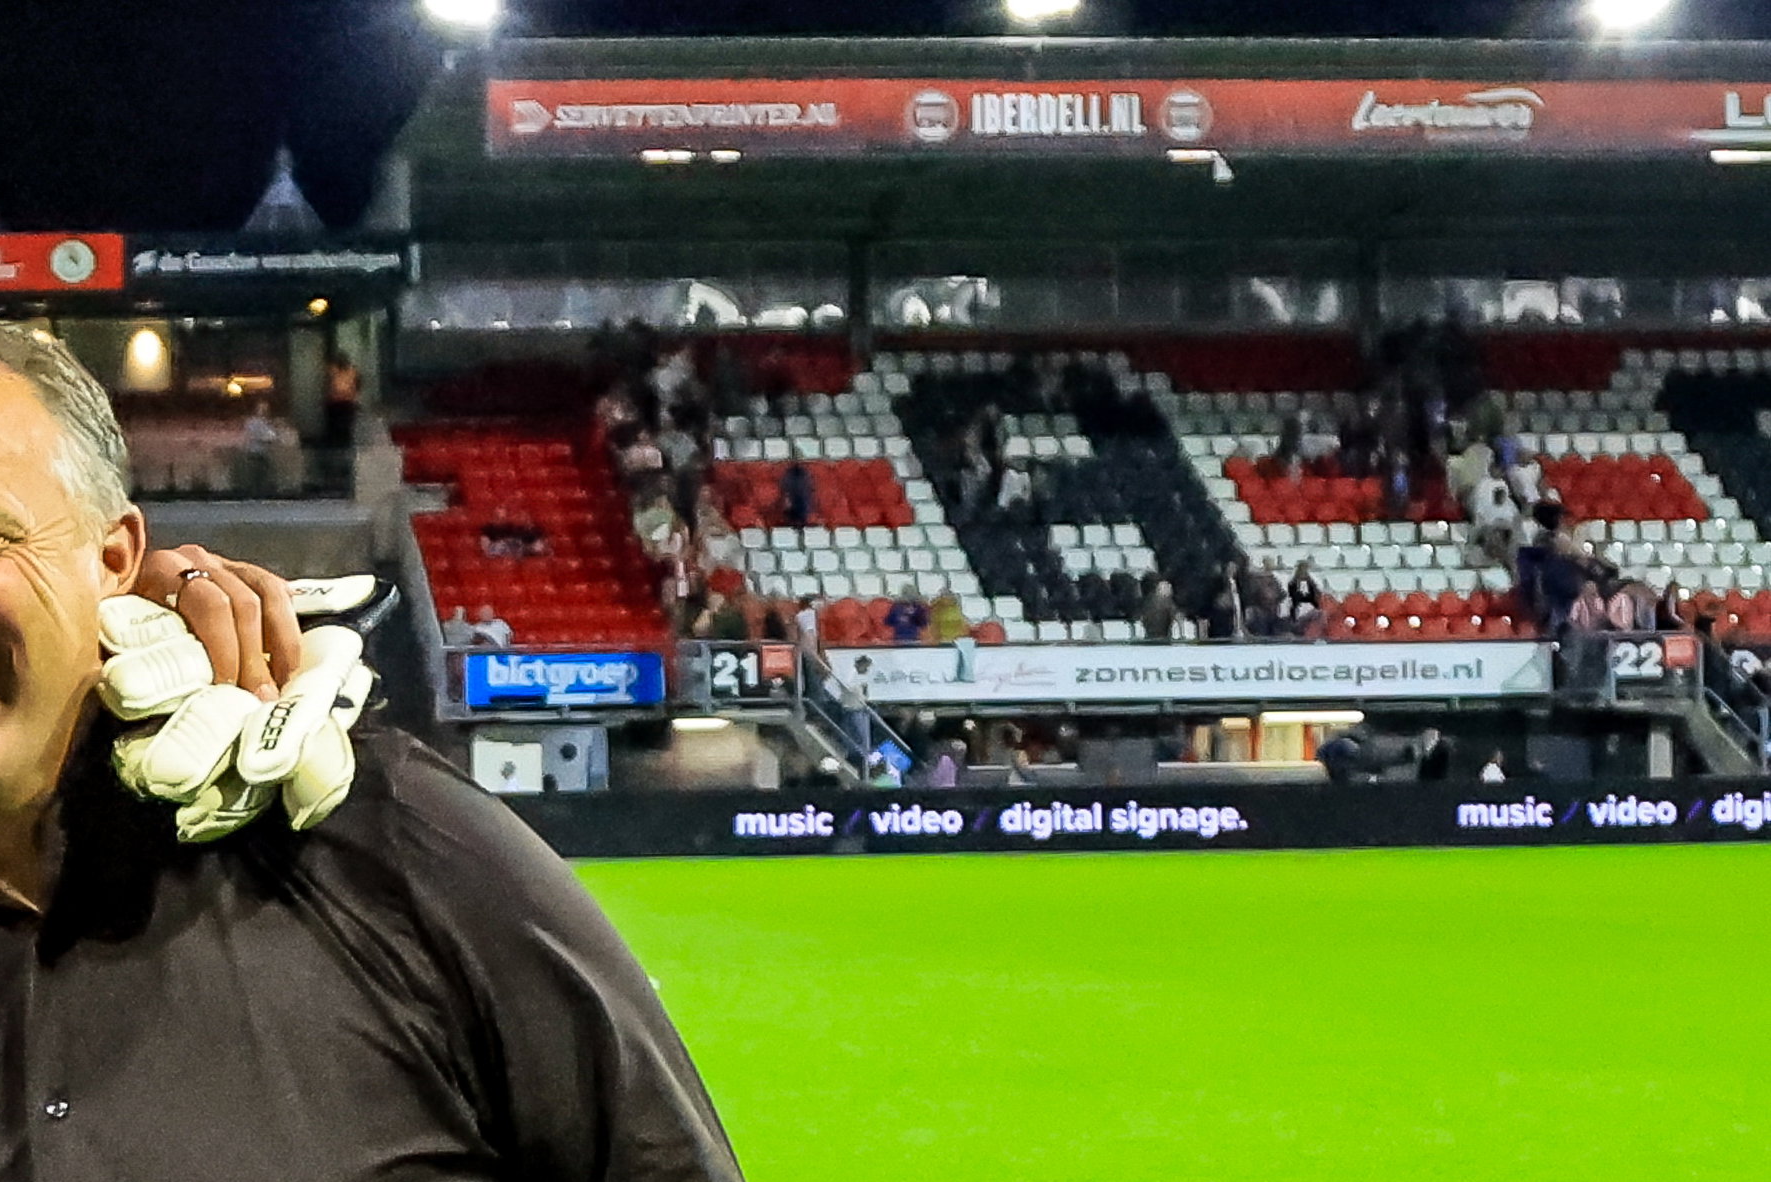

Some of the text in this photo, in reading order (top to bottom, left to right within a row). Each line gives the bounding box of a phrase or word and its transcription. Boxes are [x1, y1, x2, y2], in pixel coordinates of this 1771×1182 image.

[713, 651, 759, 687] 21
[1074, 656, 1485, 687] zonnestudiocapelle.nl
[1613, 641, 1664, 678] 22
[733, 803, 835, 837] music
[869, 802, 964, 835] video
[999, 801, 1103, 840] digital
[1109, 799, 1250, 840] signage.
[1456, 796, 1554, 828] music
[1586, 793, 1678, 828] video
